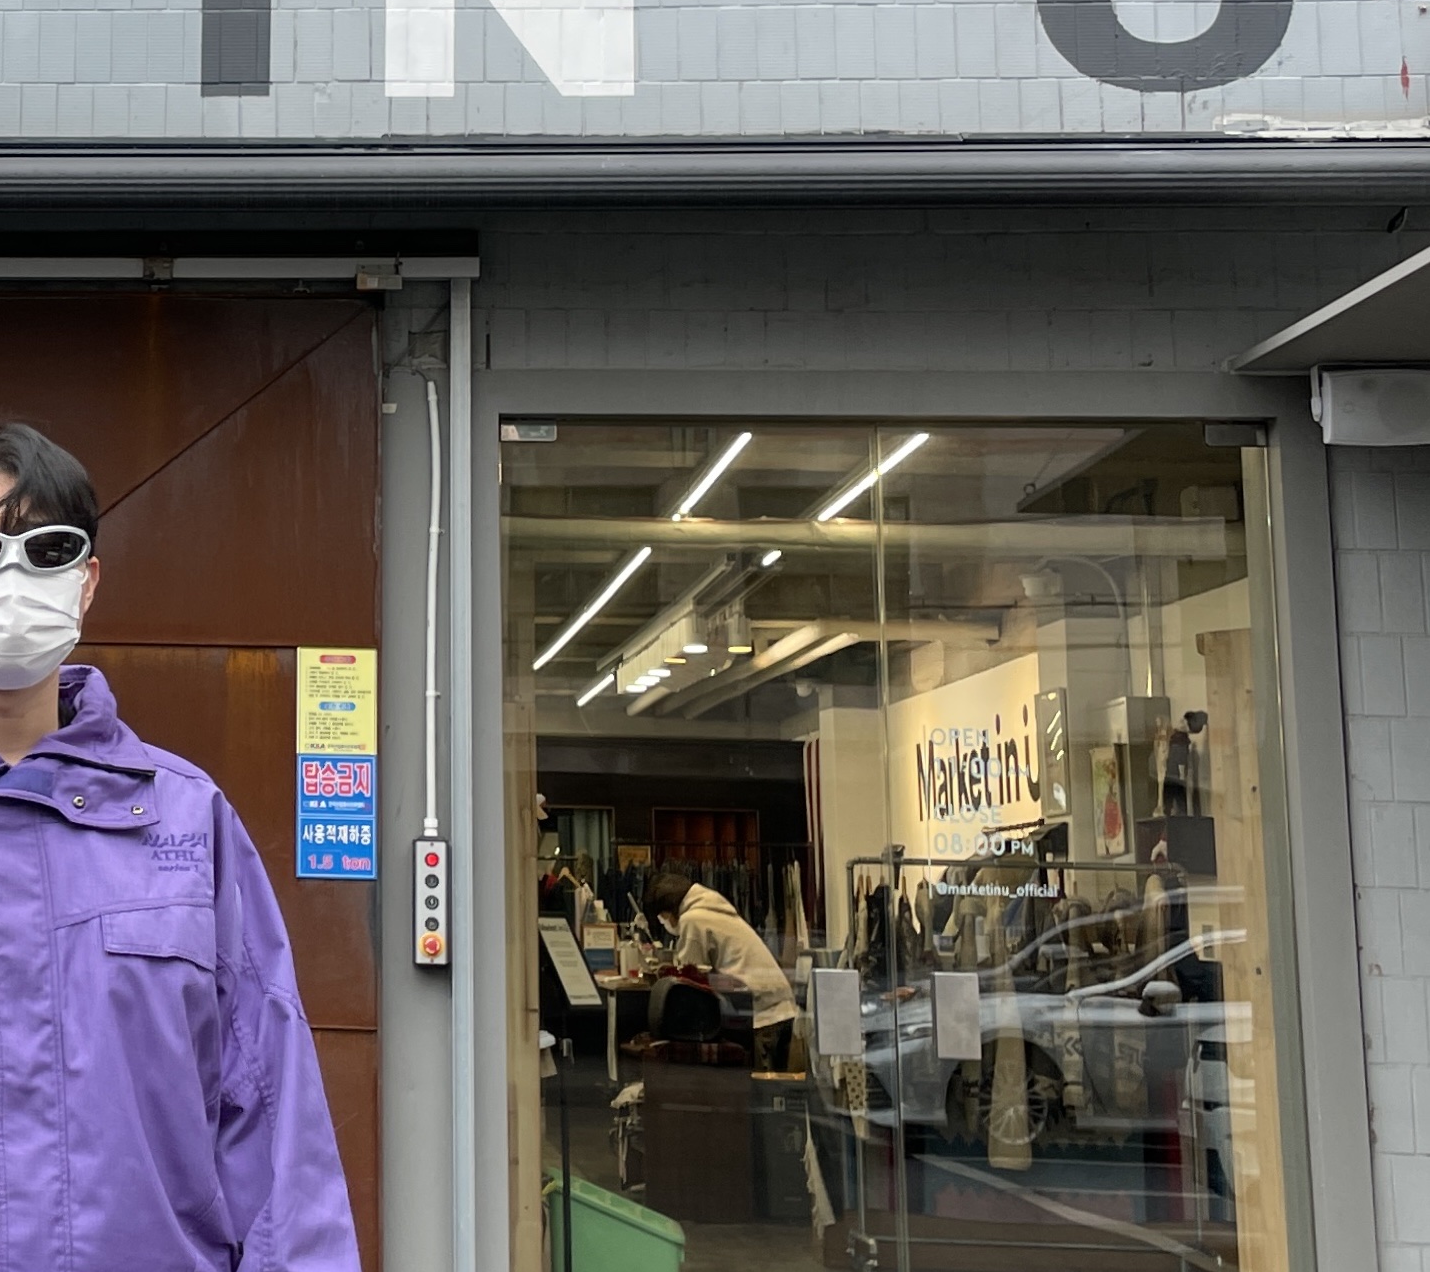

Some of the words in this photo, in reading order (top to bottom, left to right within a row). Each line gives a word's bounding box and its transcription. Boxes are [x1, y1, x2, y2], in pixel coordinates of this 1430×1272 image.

[930, 728, 989, 747] OPEN
[916, 730, 992, 822] Market
[996, 713, 1020, 805] in
[303, 761, 371, 797] 탑승금지
[934, 804, 1002, 824] CLOSE
[302, 823, 372, 845] 사용적재하중
[934, 832, 1006, 856] 08:00
[1011, 840, 1034, 856] PM
[342, 855, 371, 871] ton
[936, 881, 1059, 899] @marketinu_official
